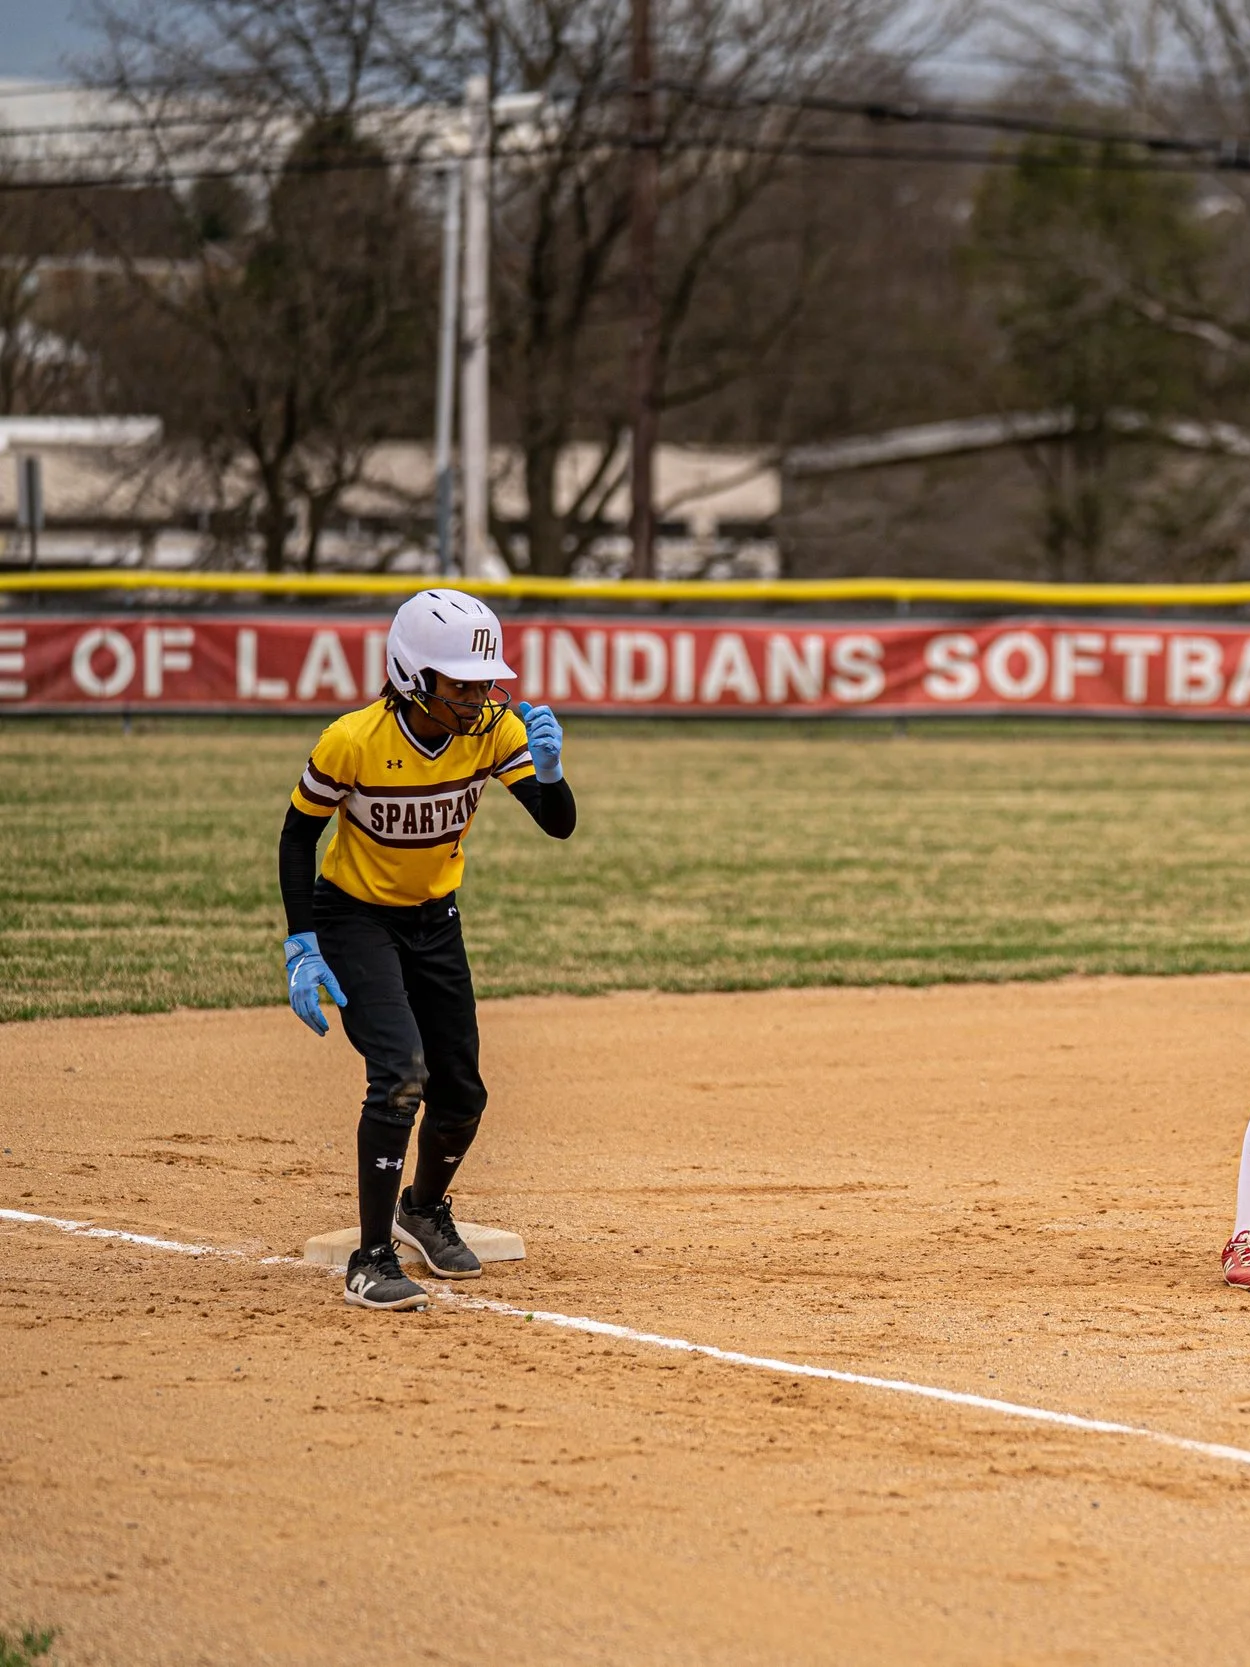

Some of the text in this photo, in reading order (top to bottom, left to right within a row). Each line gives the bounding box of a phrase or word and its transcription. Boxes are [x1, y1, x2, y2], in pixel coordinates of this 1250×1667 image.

[71, 627, 196, 699] OF
[522, 628, 887, 704] INDIANS
[370, 785, 484, 834] SPARTAN
